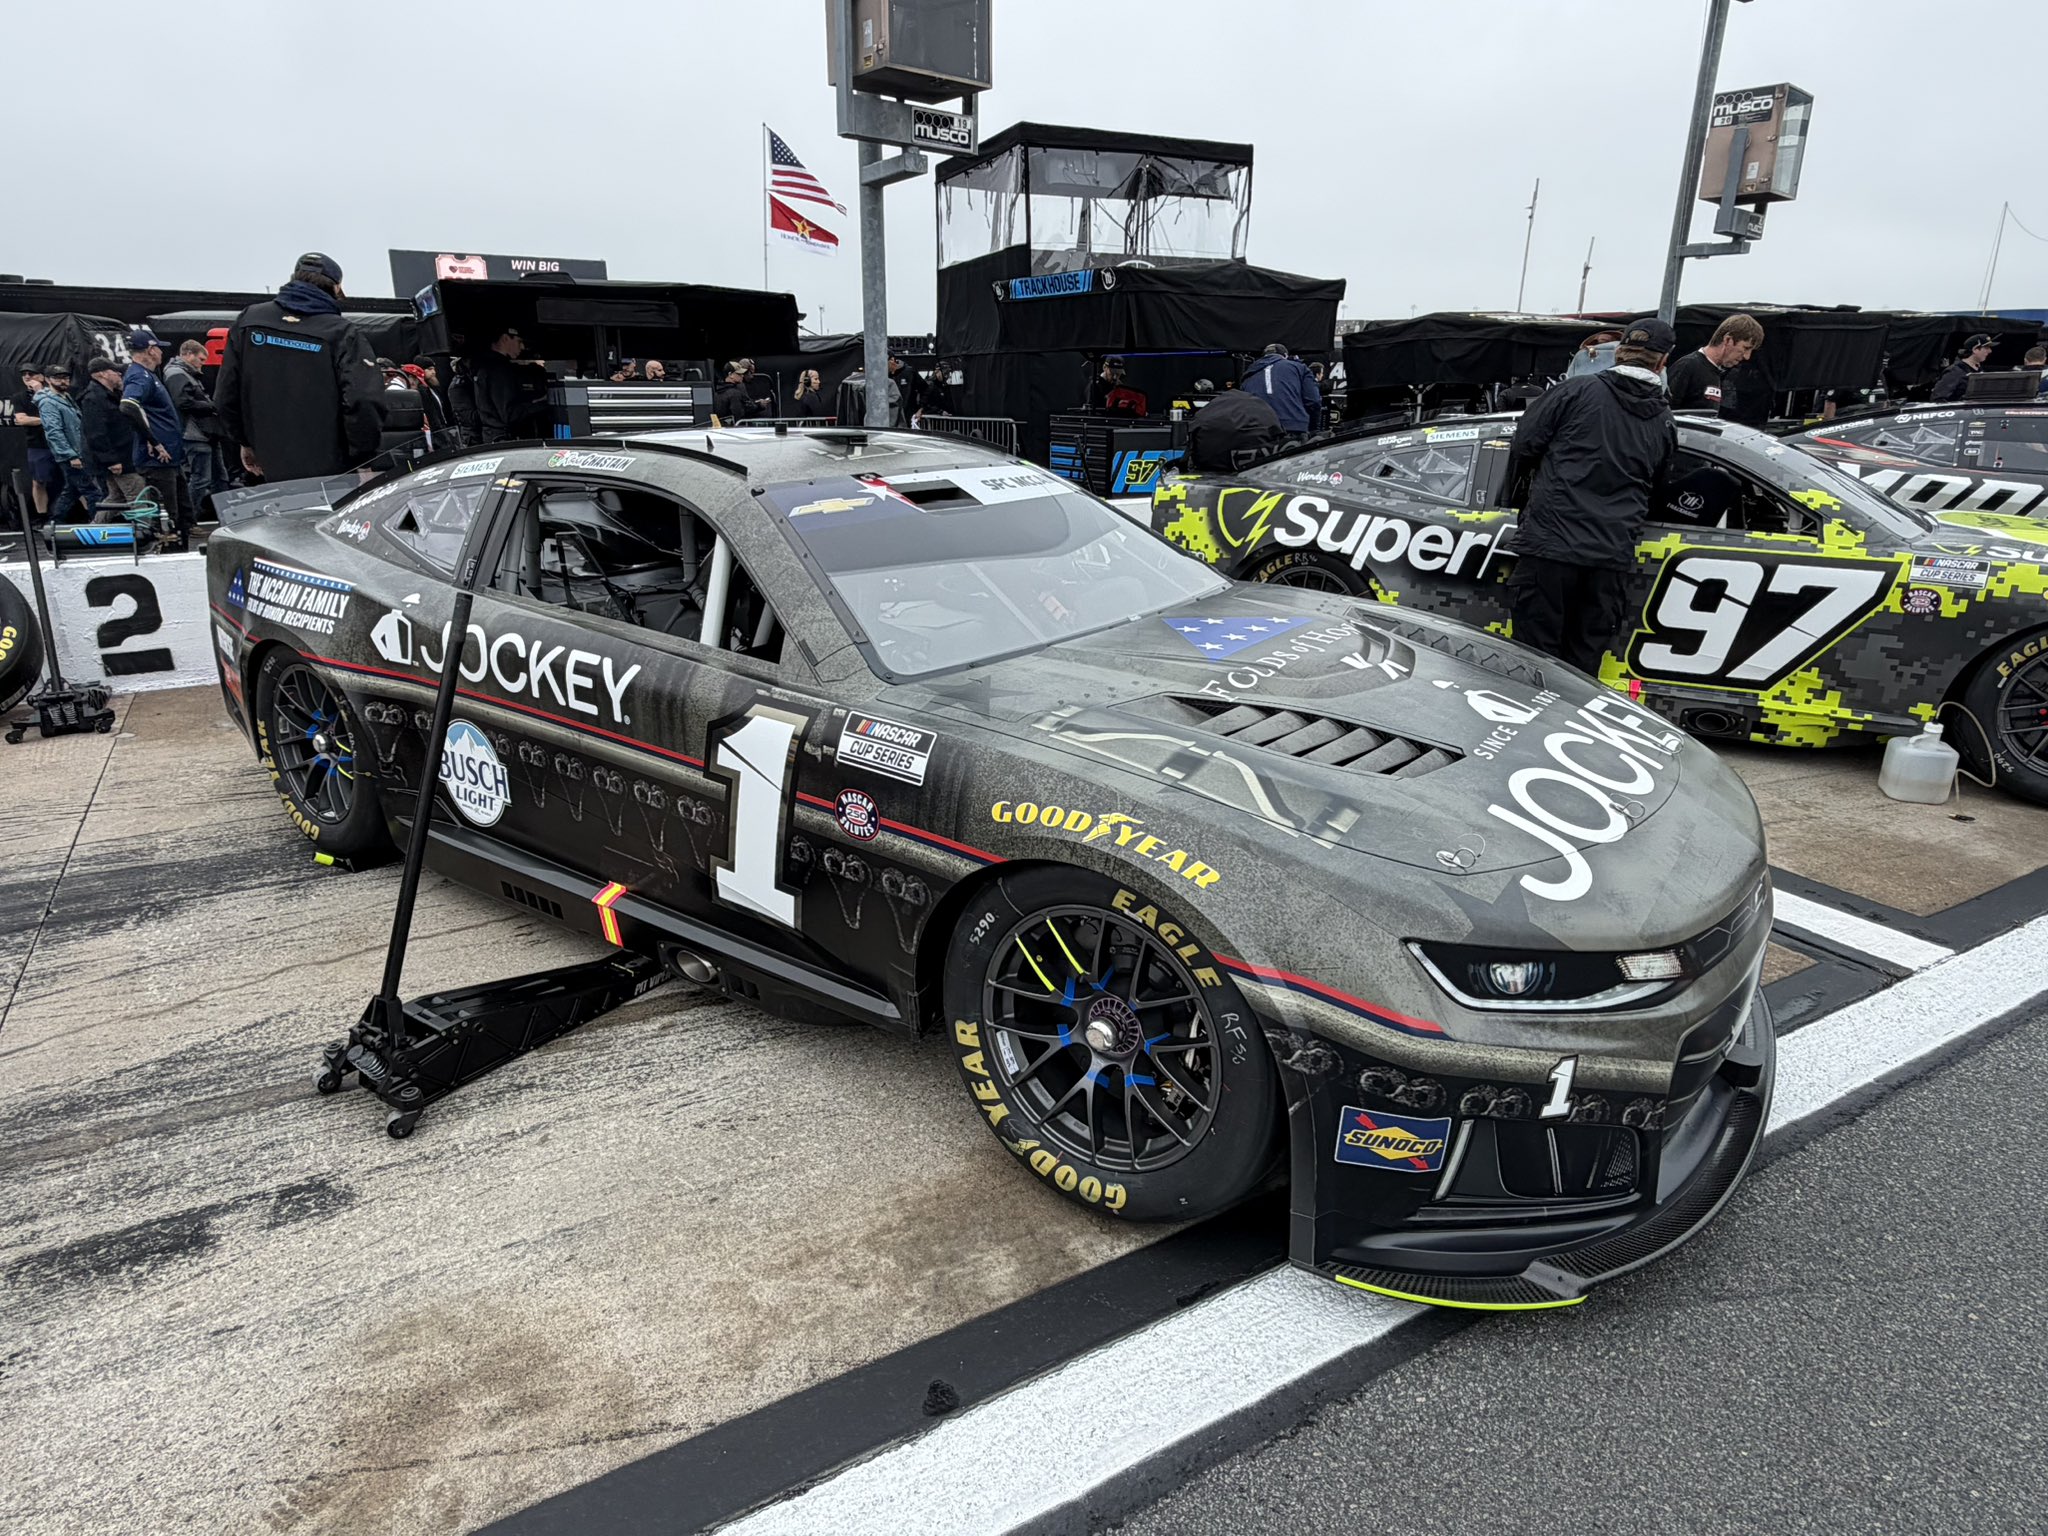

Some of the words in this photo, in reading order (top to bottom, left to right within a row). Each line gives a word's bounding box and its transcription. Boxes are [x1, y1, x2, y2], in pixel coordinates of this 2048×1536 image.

[511, 260, 536, 271] WIN
[538, 261, 560, 272] BIG
[1019, 273, 1081, 297] TRACKHOUSE
[1912, 410, 1956, 421] NEFCO
[1429, 430, 1477, 441] SIEMENS
[455, 461, 499, 475] SIEMENS
[582, 454, 632, 471] CHASTAIN
[1126, 460, 1161, 484] 97
[981, 478, 1017, 491] SFC
[1297, 471, 1329, 484] Wendy's
[1920, 568, 1939, 578] CUP
[1940, 570, 1977, 582] SERIES
[1935, 559, 1979, 570] NASCAR
[247, 571, 263, 596] THE
[259, 576, 302, 609] MCCAIN
[297, 587, 350, 619] FAMILY
[85, 574, 175, 677] 2
[261, 602, 286, 622] HONOR
[283, 610, 335, 635] RECIPIENTS
[1638, 556, 1886, 682] 97
[420, 620, 641, 723] JOCKEY
[870, 722, 922, 748] NASCAR
[1473, 725, 1519, 761] SINCE
[850, 740, 874, 759] CUP
[872, 748, 915, 770] SERIES
[440, 749, 509, 801] BUSCH
[455, 784, 496, 811] LIGHT
[840, 792, 874, 813] NASCAR
[1487, 691, 1686, 902] JOCKEY
[716, 714, 796, 930] 1
[839, 814, 875, 839] SALUTES
[846, 808, 867, 823] 250
[969, 912, 995, 946] 5290
[1111, 888, 1222, 989] EAGLE
[1220, 1012, 1247, 1039] RF
[1540, 1056, 1579, 1119] 1
[1346, 1129, 1443, 1156] SUNOCO
